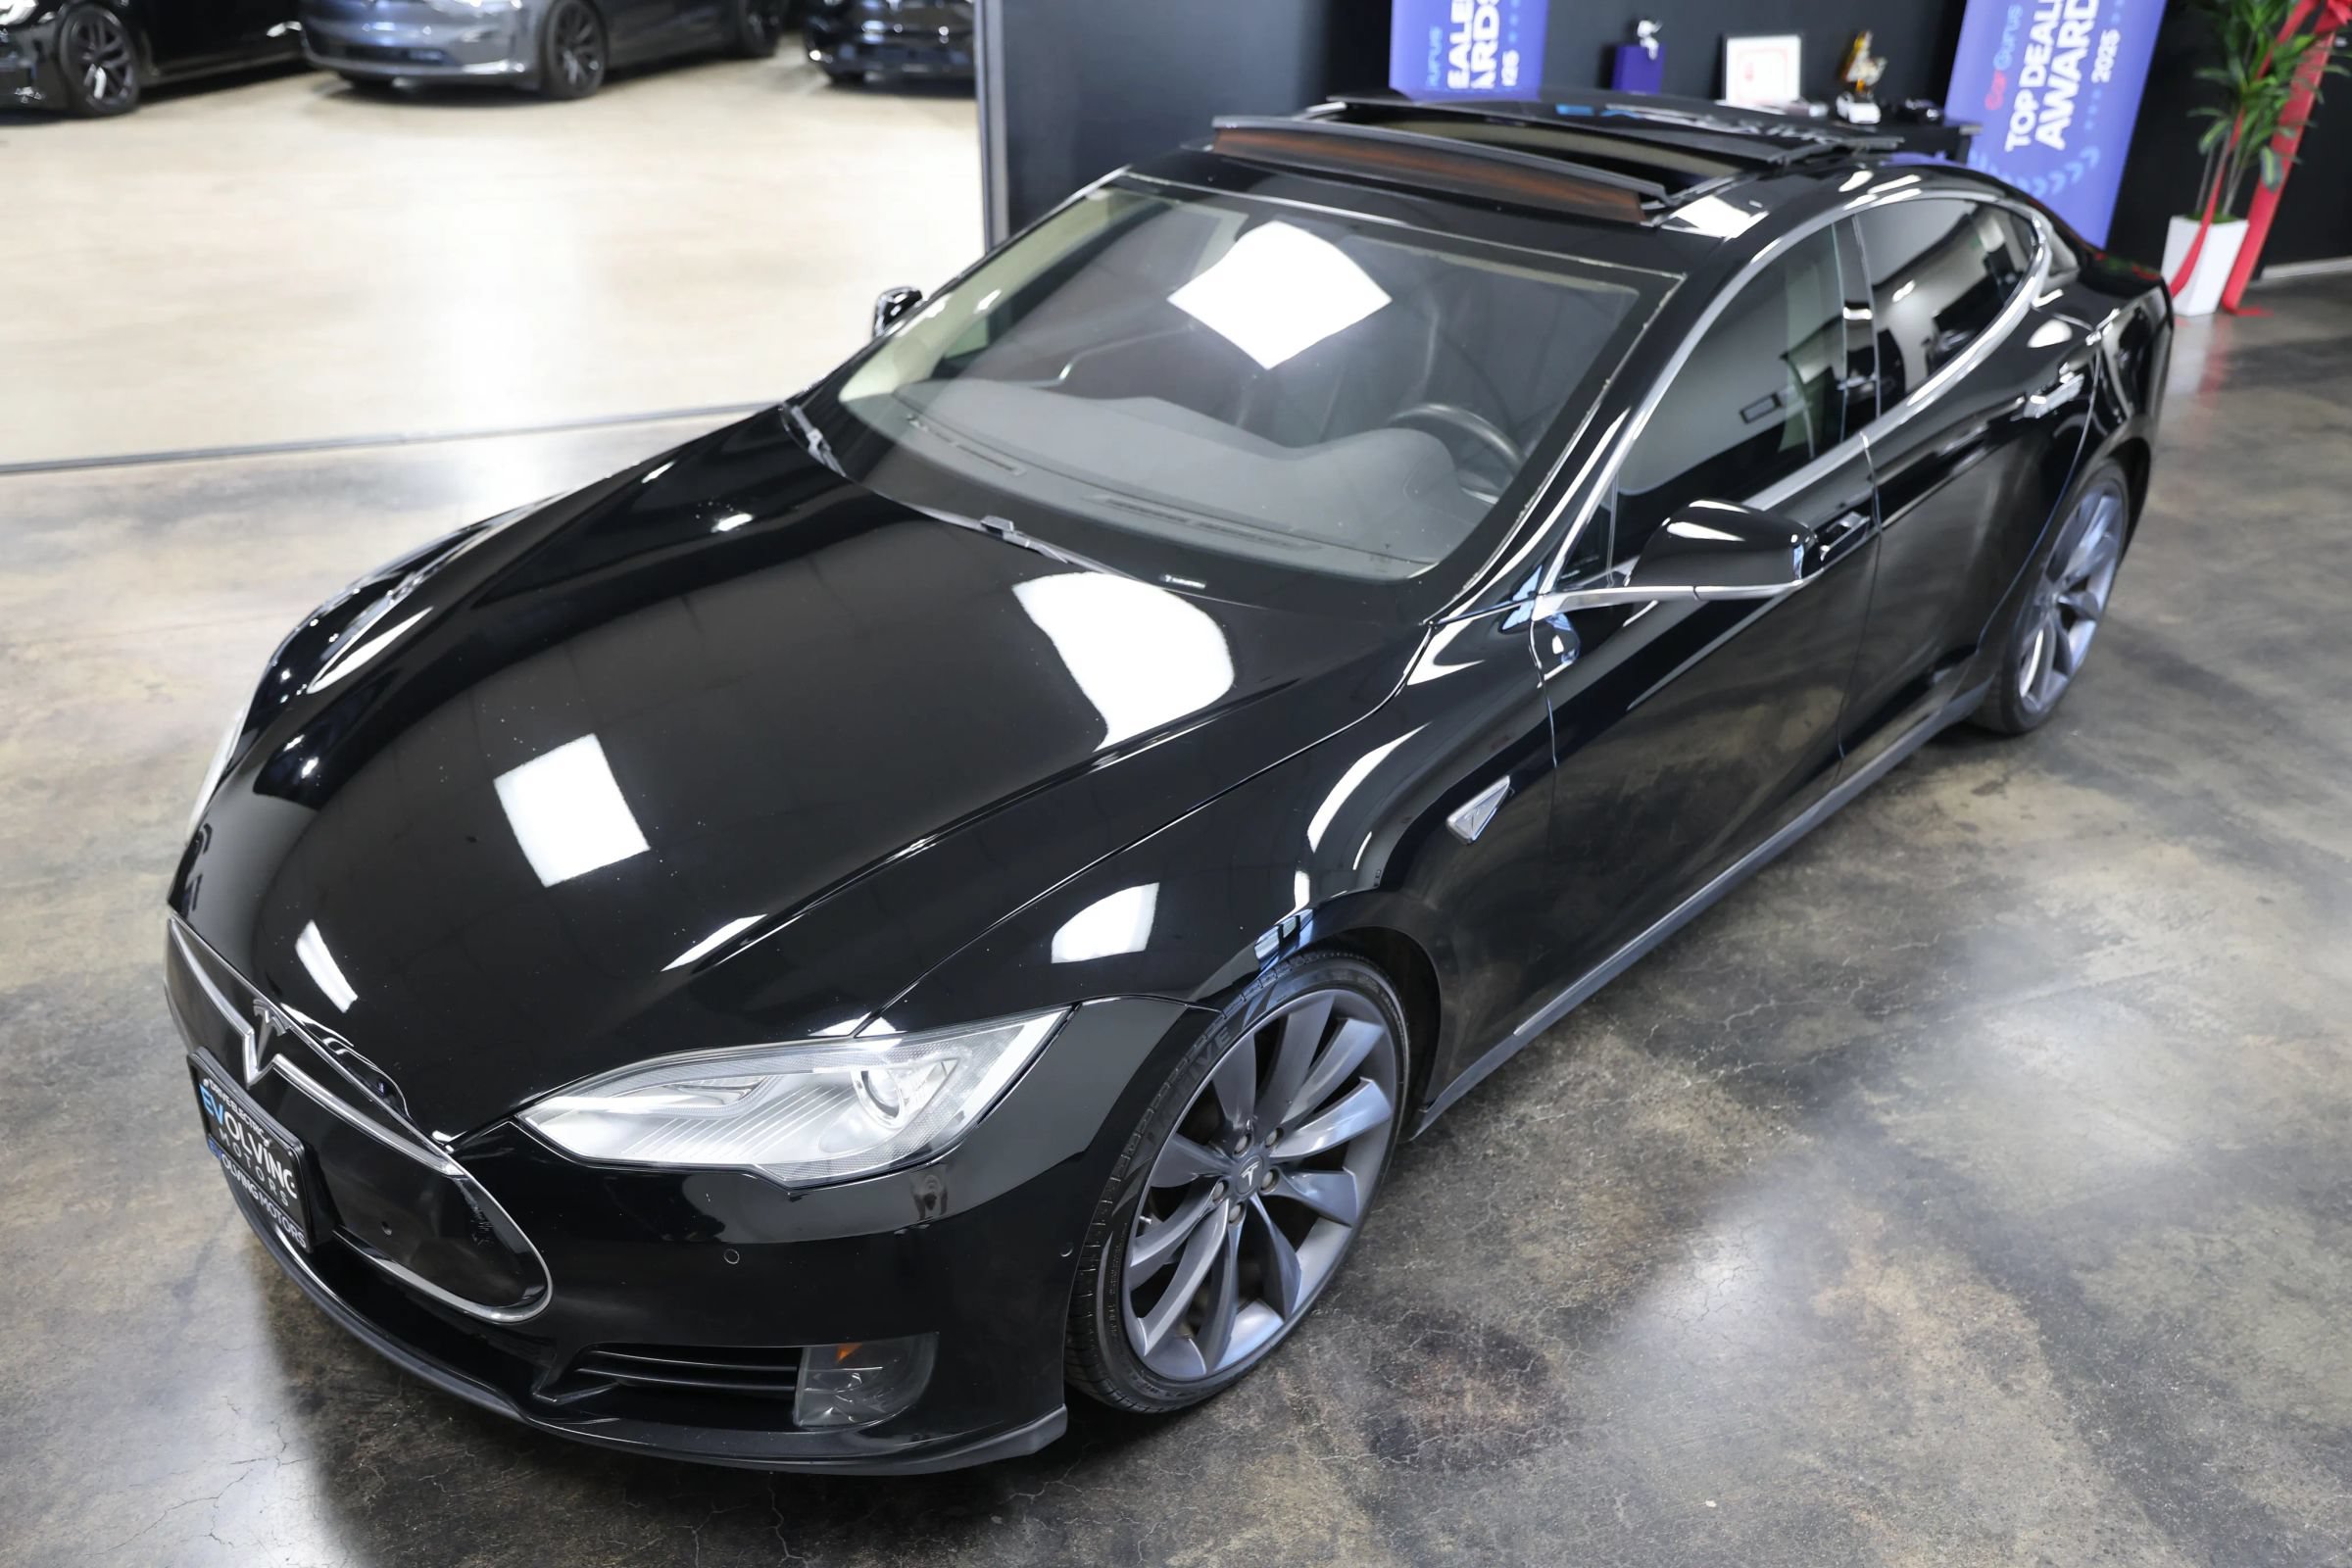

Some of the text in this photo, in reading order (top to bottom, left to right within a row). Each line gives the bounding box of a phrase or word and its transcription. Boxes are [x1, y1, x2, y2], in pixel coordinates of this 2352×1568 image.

[1447, 0, 1474, 89] EALE
[1470, 0, 1500, 89] ARD
[1984, 5, 2023, 110] CarGurus
[2004, 0, 2063, 152] TOP DEAL
[2035, 0, 2100, 150] AWARD
[2090, 28, 2121, 83] 2025
[199, 1083, 298, 1199] EVOLVING
[208, 1138, 307, 1249] EVOLVING MOTORS
[219, 1127, 289, 1206] MOTORS
